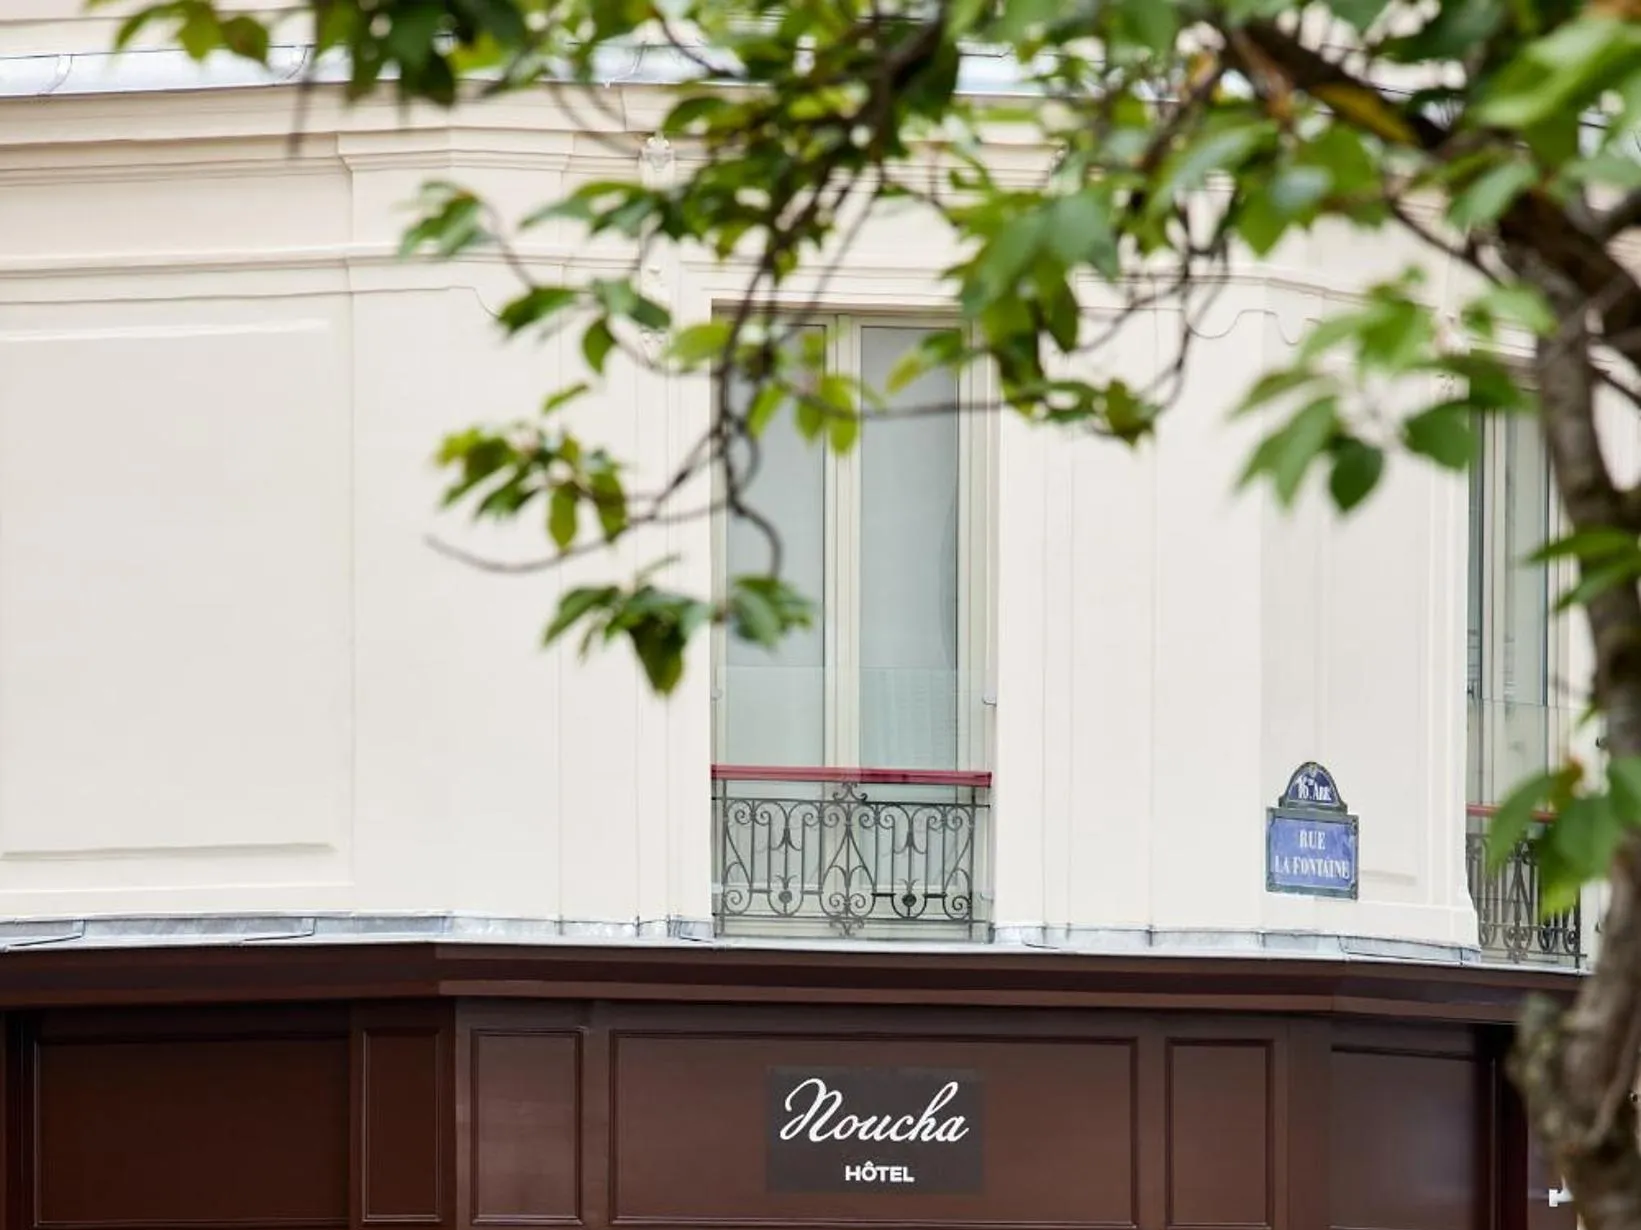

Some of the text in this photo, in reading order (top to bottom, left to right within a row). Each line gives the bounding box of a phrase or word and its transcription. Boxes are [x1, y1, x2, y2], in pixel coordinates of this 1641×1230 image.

[1299, 829, 1326, 850] RUE
[1274, 855, 1350, 879] LA FONTAINE
[780, 1078, 969, 1142] Noucha
[845, 1161, 914, 1182] HÔTEL
